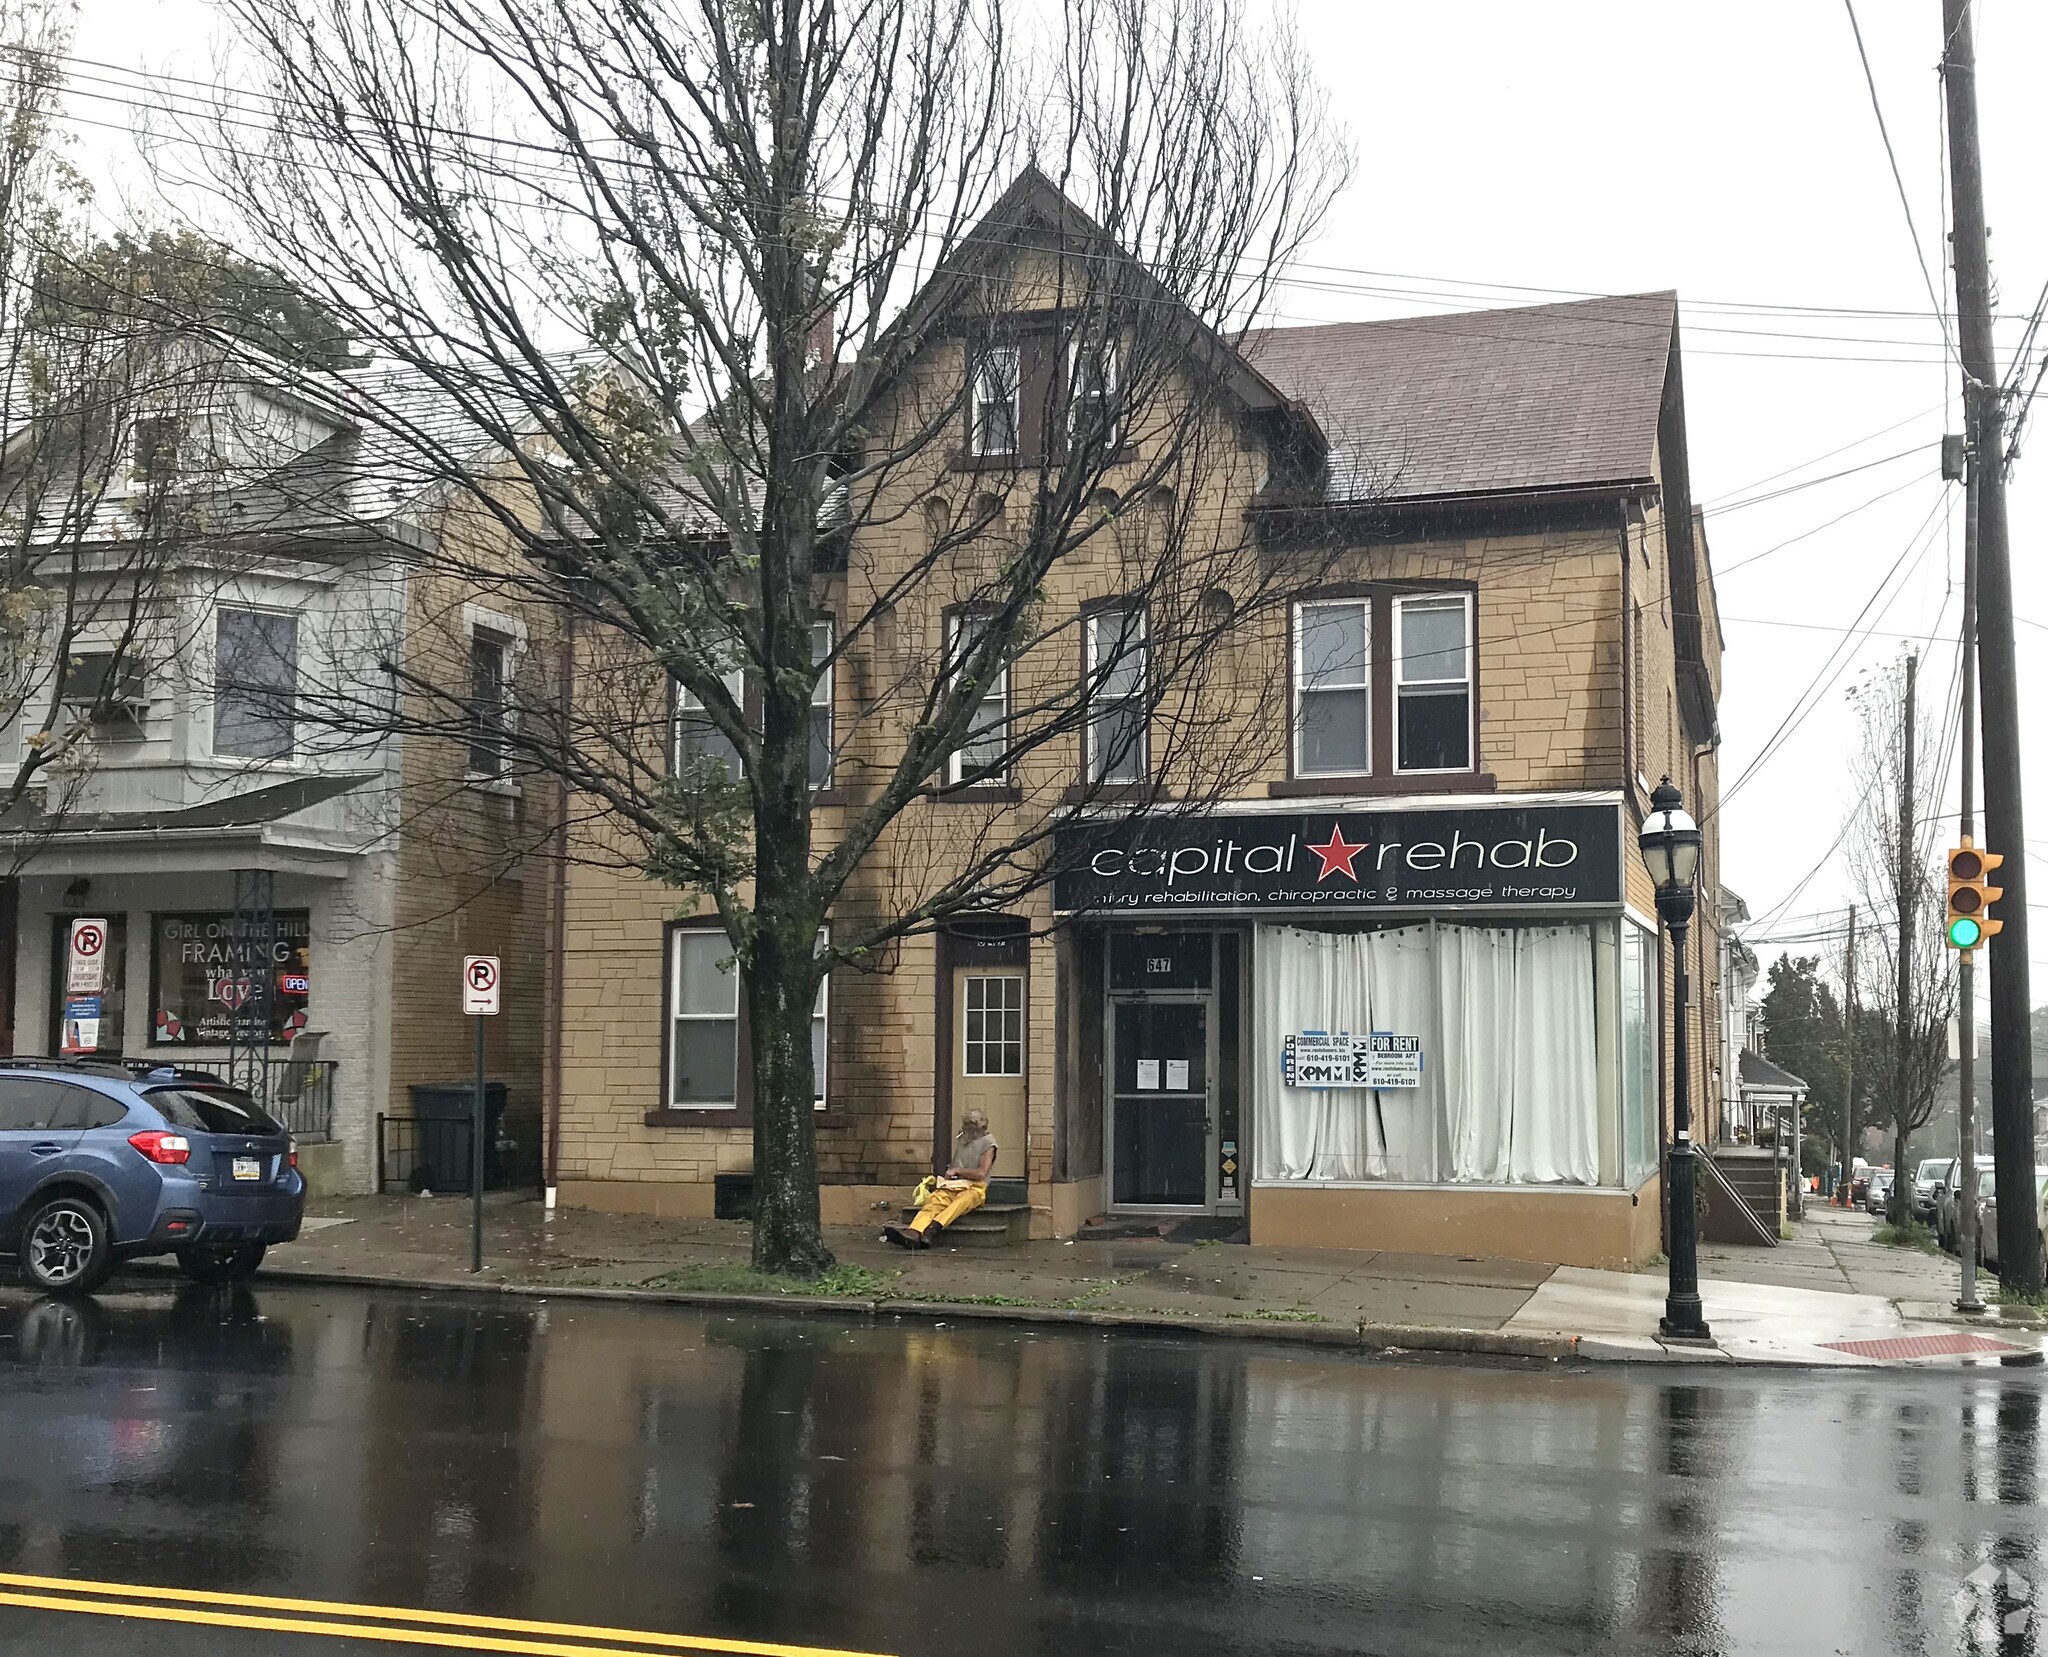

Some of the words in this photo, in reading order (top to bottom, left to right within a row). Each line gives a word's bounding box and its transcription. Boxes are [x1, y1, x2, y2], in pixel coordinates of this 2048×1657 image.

[1091, 833, 1297, 886] capital
[1376, 827, 1579, 871] rehab
[1144, 889, 1261, 904] rehabilitation,
[1268, 887, 1377, 903] chiropractic
[1385, 886, 1398, 901] &
[1406, 888, 1493, 900] massage
[1501, 884, 1577, 899] therapy
[165, 923, 201, 939] GIRL
[206, 923, 233, 938] ON
[277, 922, 309, 937] HILL
[182, 941, 290, 963] FRAMING
[205, 965, 237, 978] wha
[1148, 959, 1170, 972] 647
[207, 978, 264, 1001] Love
[1296, 1036, 1331, 1046] COMMERCIAL
[1332, 1036, 1349, 1046] SPACE
[1371, 1037, 1390, 1051] FOR
[1393, 1037, 1418, 1051] RENT
[1286, 1058, 1295, 1086] RENT
